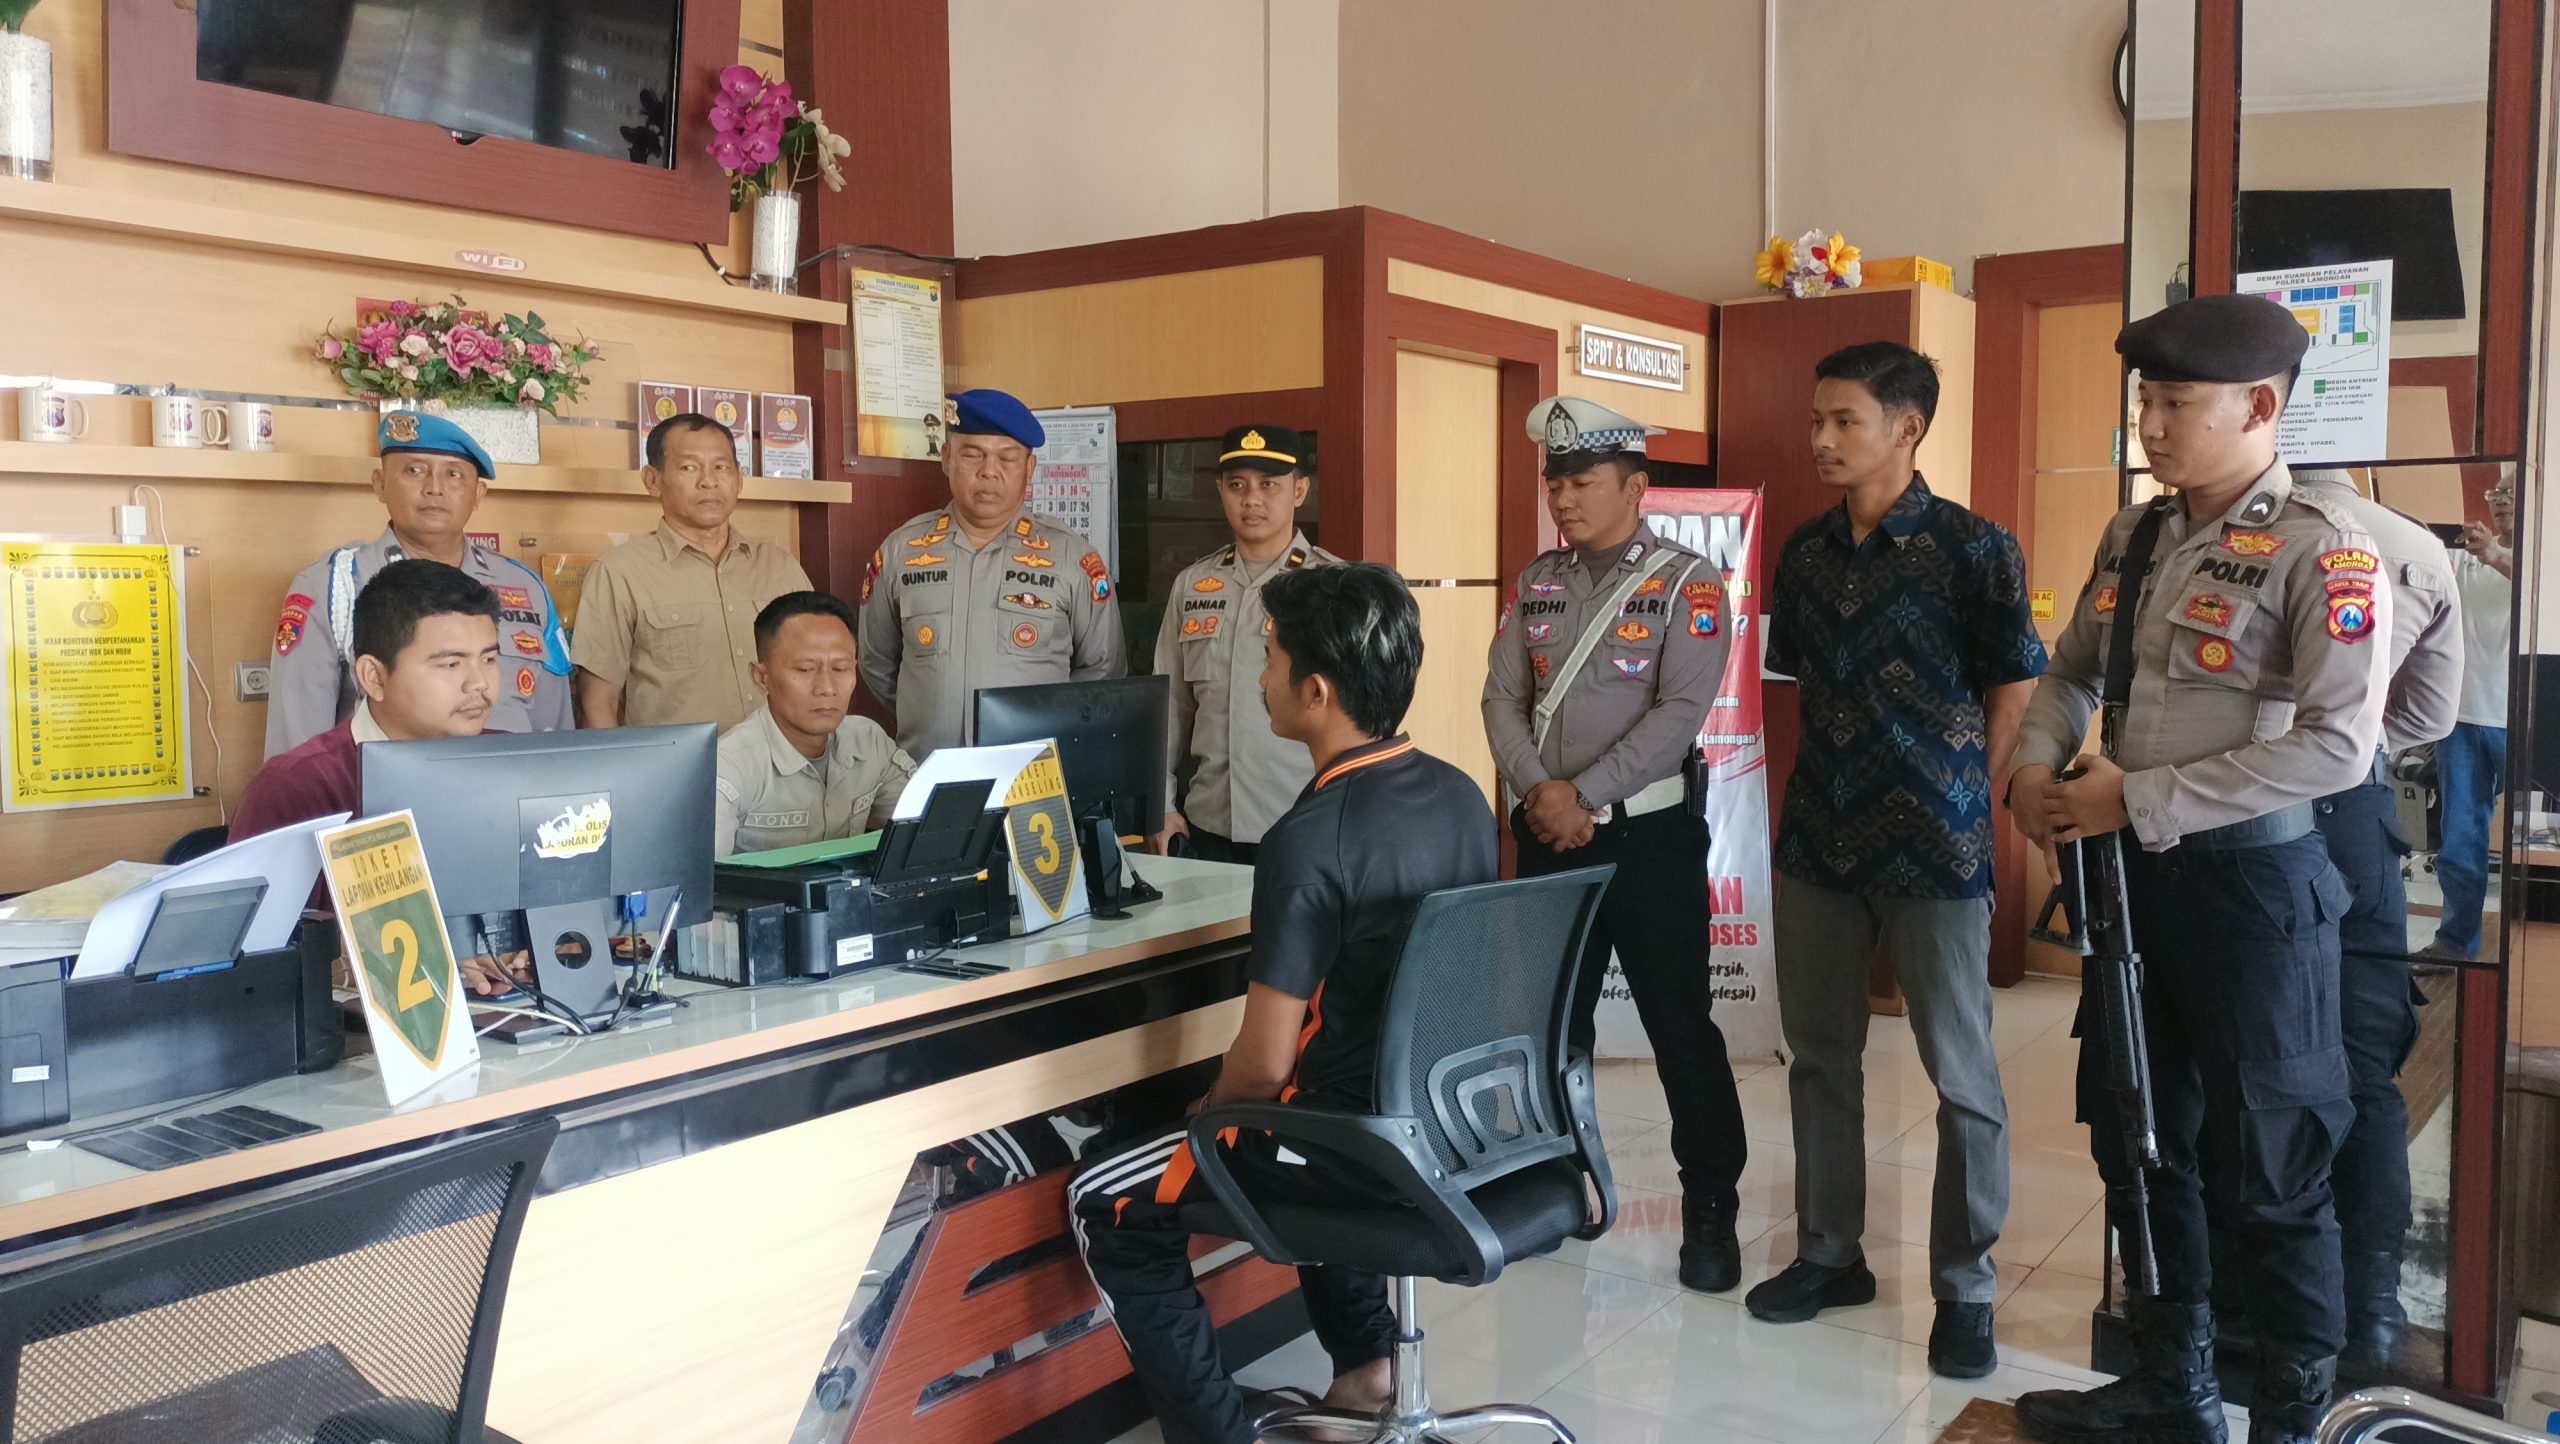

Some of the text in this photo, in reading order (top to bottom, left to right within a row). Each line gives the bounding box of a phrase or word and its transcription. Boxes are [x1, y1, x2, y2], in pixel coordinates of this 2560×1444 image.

[2256, 266, 2369, 282] DENAH RUANGAN PELAYANAN
[2275, 275, 2351, 286] POLRES LAMONGAN
[1586, 337, 1680, 380] SPDT & KONSULTASI
[1049, 485, 1054, 496] 2
[1060, 485, 1065, 496] 9
[1070, 485, 1078, 496] 16
[1049, 501, 1054, 512] 3
[1059, 501, 1066, 512] 10
[1069, 501, 1078, 512] 17
[1081, 501, 1090, 512] 24
[1069, 517, 1090, 528] 18 25
[468, 537, 496, 550] KING
[2324, 551, 2376, 571] POLRES
[2333, 561, 2369, 569] AMONGA
[901, 570, 948, 586] GUNTUR
[1005, 570, 1055, 589] POLRI
[2195, 557, 2270, 589] POLRI
[2041, 592, 2052, 601] AC
[1184, 600, 1227, 612] DANIAR
[1522, 600, 1567, 617] DEDHI
[1620, 599, 1666, 616] OLRI
[500, 610, 541, 627] OLRI
[94, 636, 146, 645] MEMPERTAHANKAN
[60, 648, 88, 657] PREDIKAT
[1704, 733, 1756, 745] Lamongan
[1014, 762, 1046, 783] OKET
[585, 820, 607, 831] OLIS
[754, 814, 802, 826] YONO
[1029, 812, 1060, 875] 3
[352, 845, 402, 879] LOKET
[341, 864, 423, 908] LAPORAN KEHILANGAN
[381, 919, 434, 1013] 2
[1710, 962, 1750, 978] ersih,
[1710, 985, 1756, 1001] elesai)
